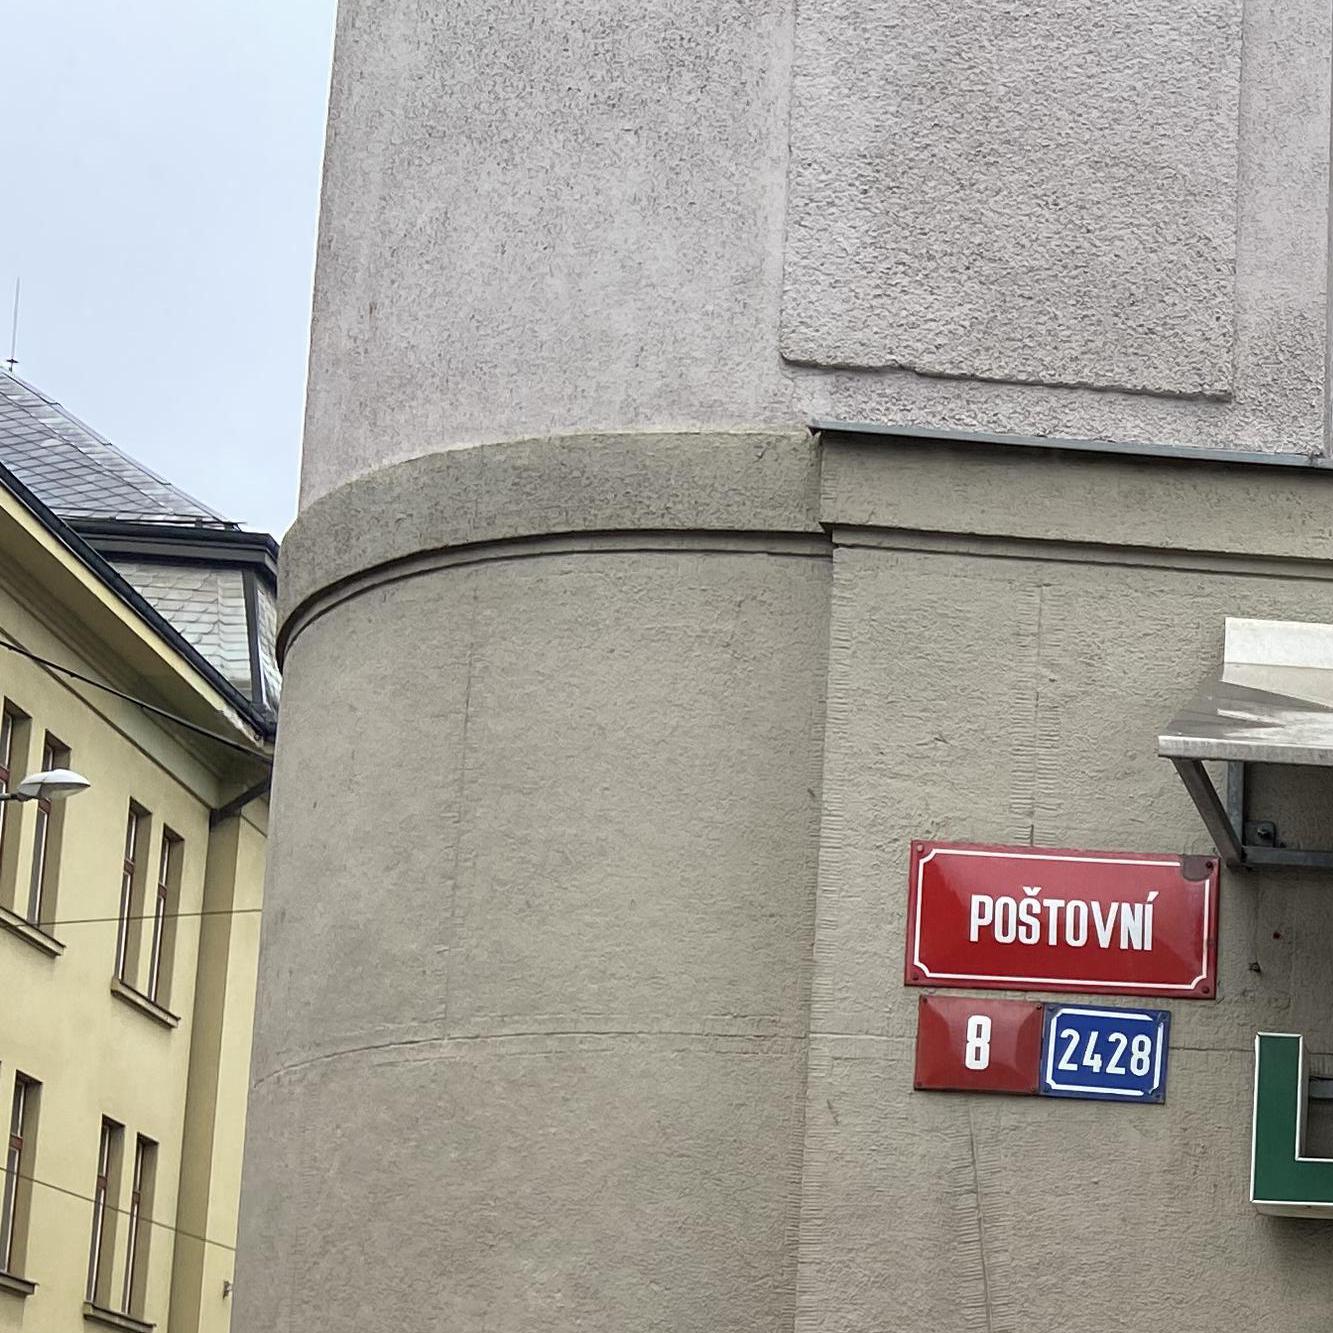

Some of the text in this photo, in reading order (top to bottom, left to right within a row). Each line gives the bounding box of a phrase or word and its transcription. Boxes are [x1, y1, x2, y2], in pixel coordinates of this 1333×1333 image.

[968, 885, 1160, 951] POŠTOVNÍ
[964, 1014, 993, 1071] 8
[1057, 1027, 1152, 1077] 2428
